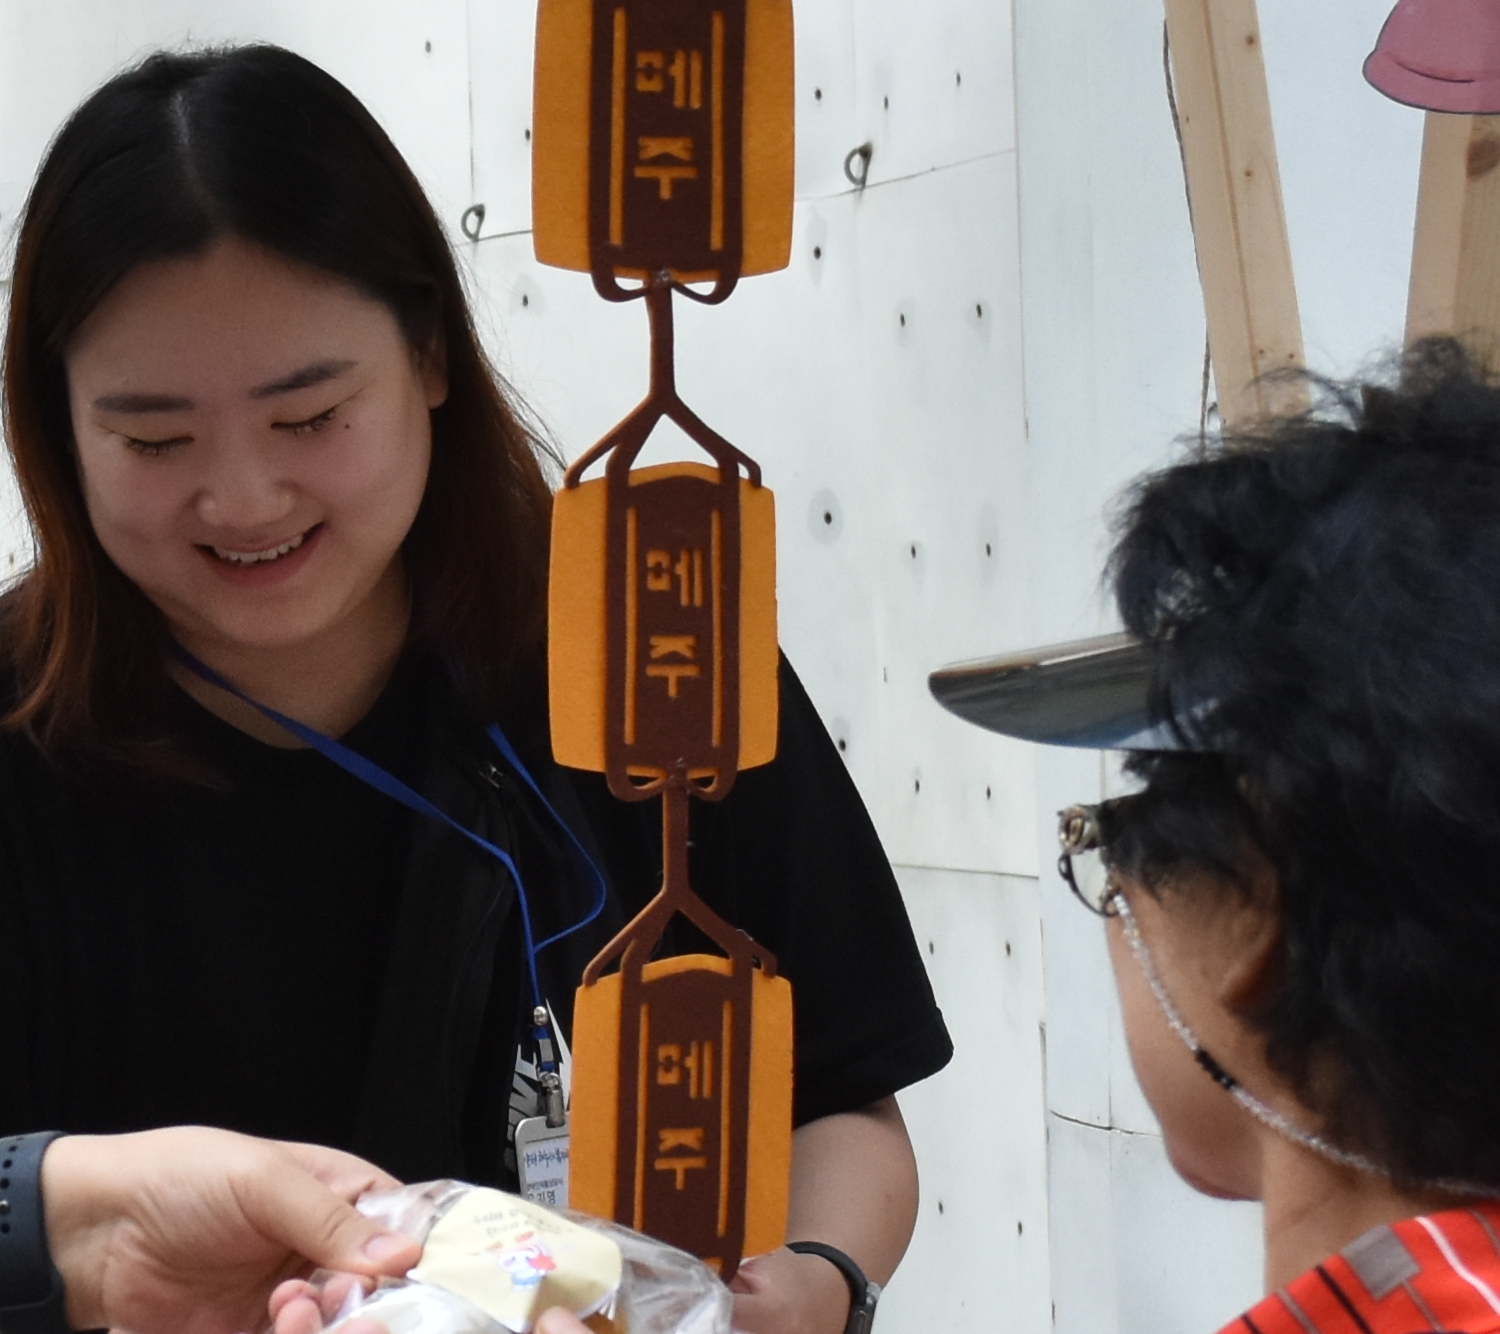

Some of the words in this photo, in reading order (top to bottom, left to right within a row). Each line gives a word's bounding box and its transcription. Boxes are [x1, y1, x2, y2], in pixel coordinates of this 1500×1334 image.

[635, 52, 702, 199] 메주
[646, 550, 703, 699] 메주
[655, 1040, 712, 1190] 메주
